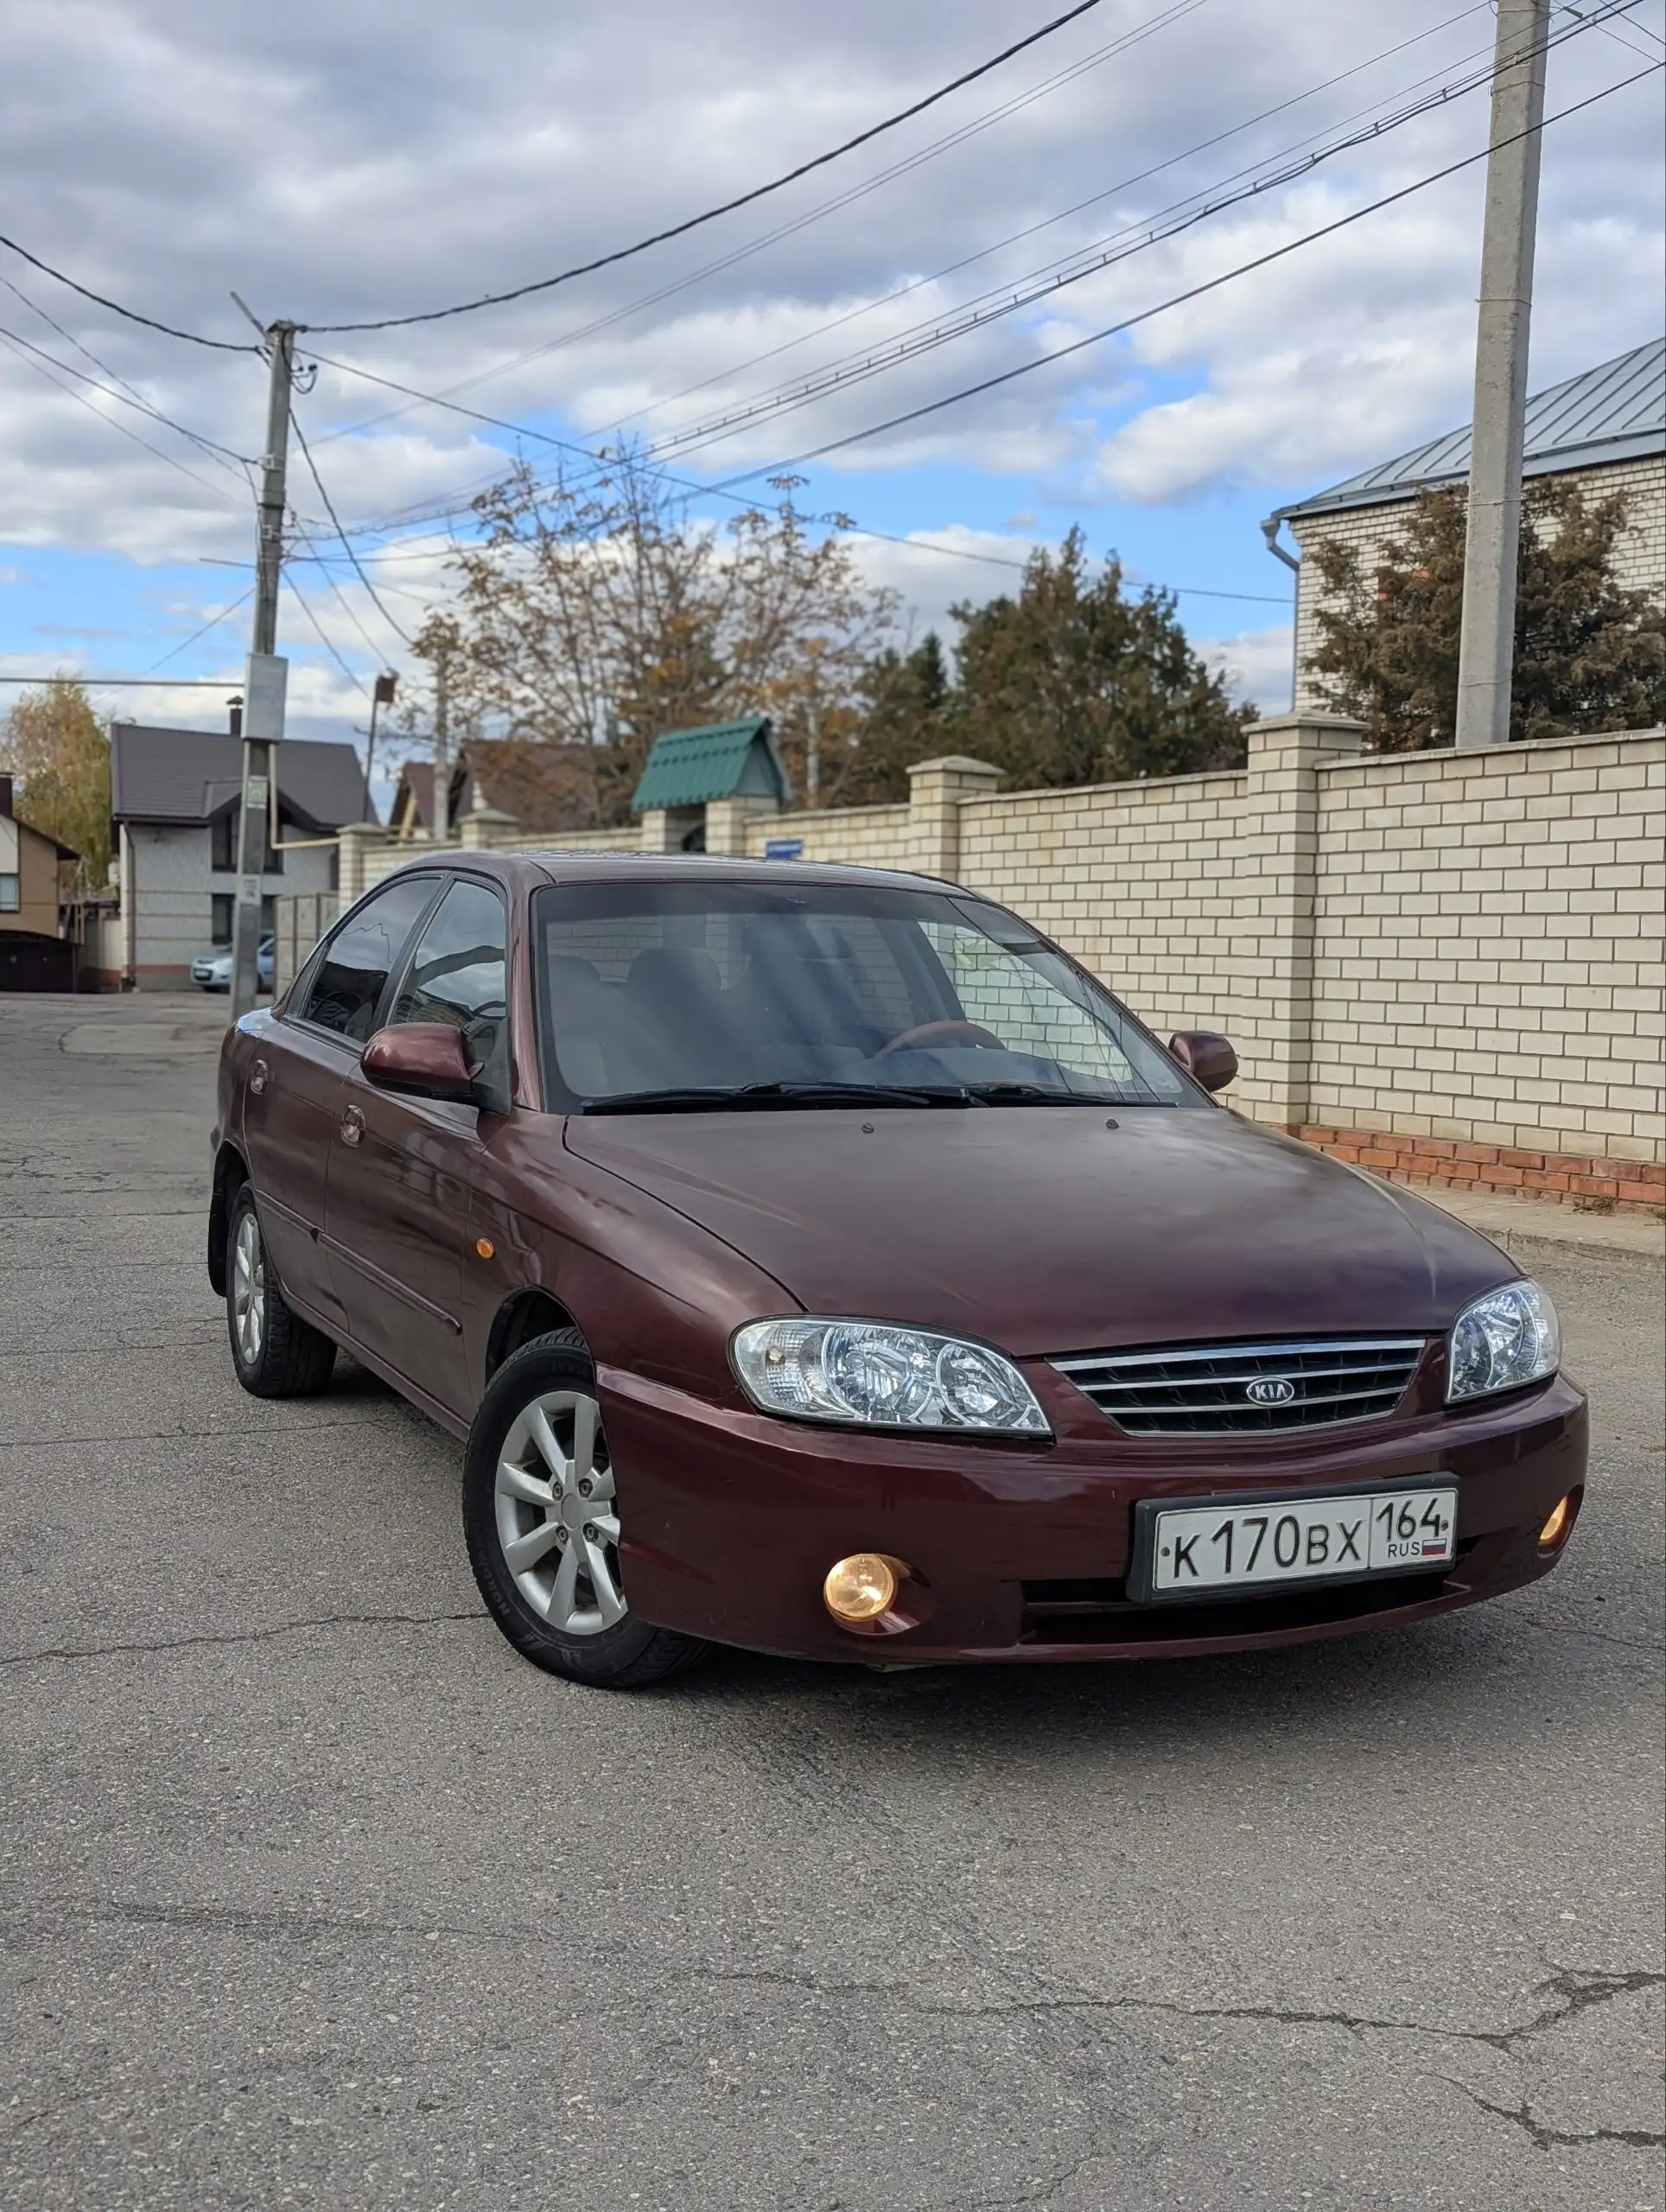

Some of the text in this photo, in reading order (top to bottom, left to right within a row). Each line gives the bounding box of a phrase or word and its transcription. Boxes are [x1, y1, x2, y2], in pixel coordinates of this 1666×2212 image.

[1255, 1384, 1289, 1400] KIA
[1376, 1497, 1441, 1542] 164
[1387, 1541, 1421, 1558] RUS
